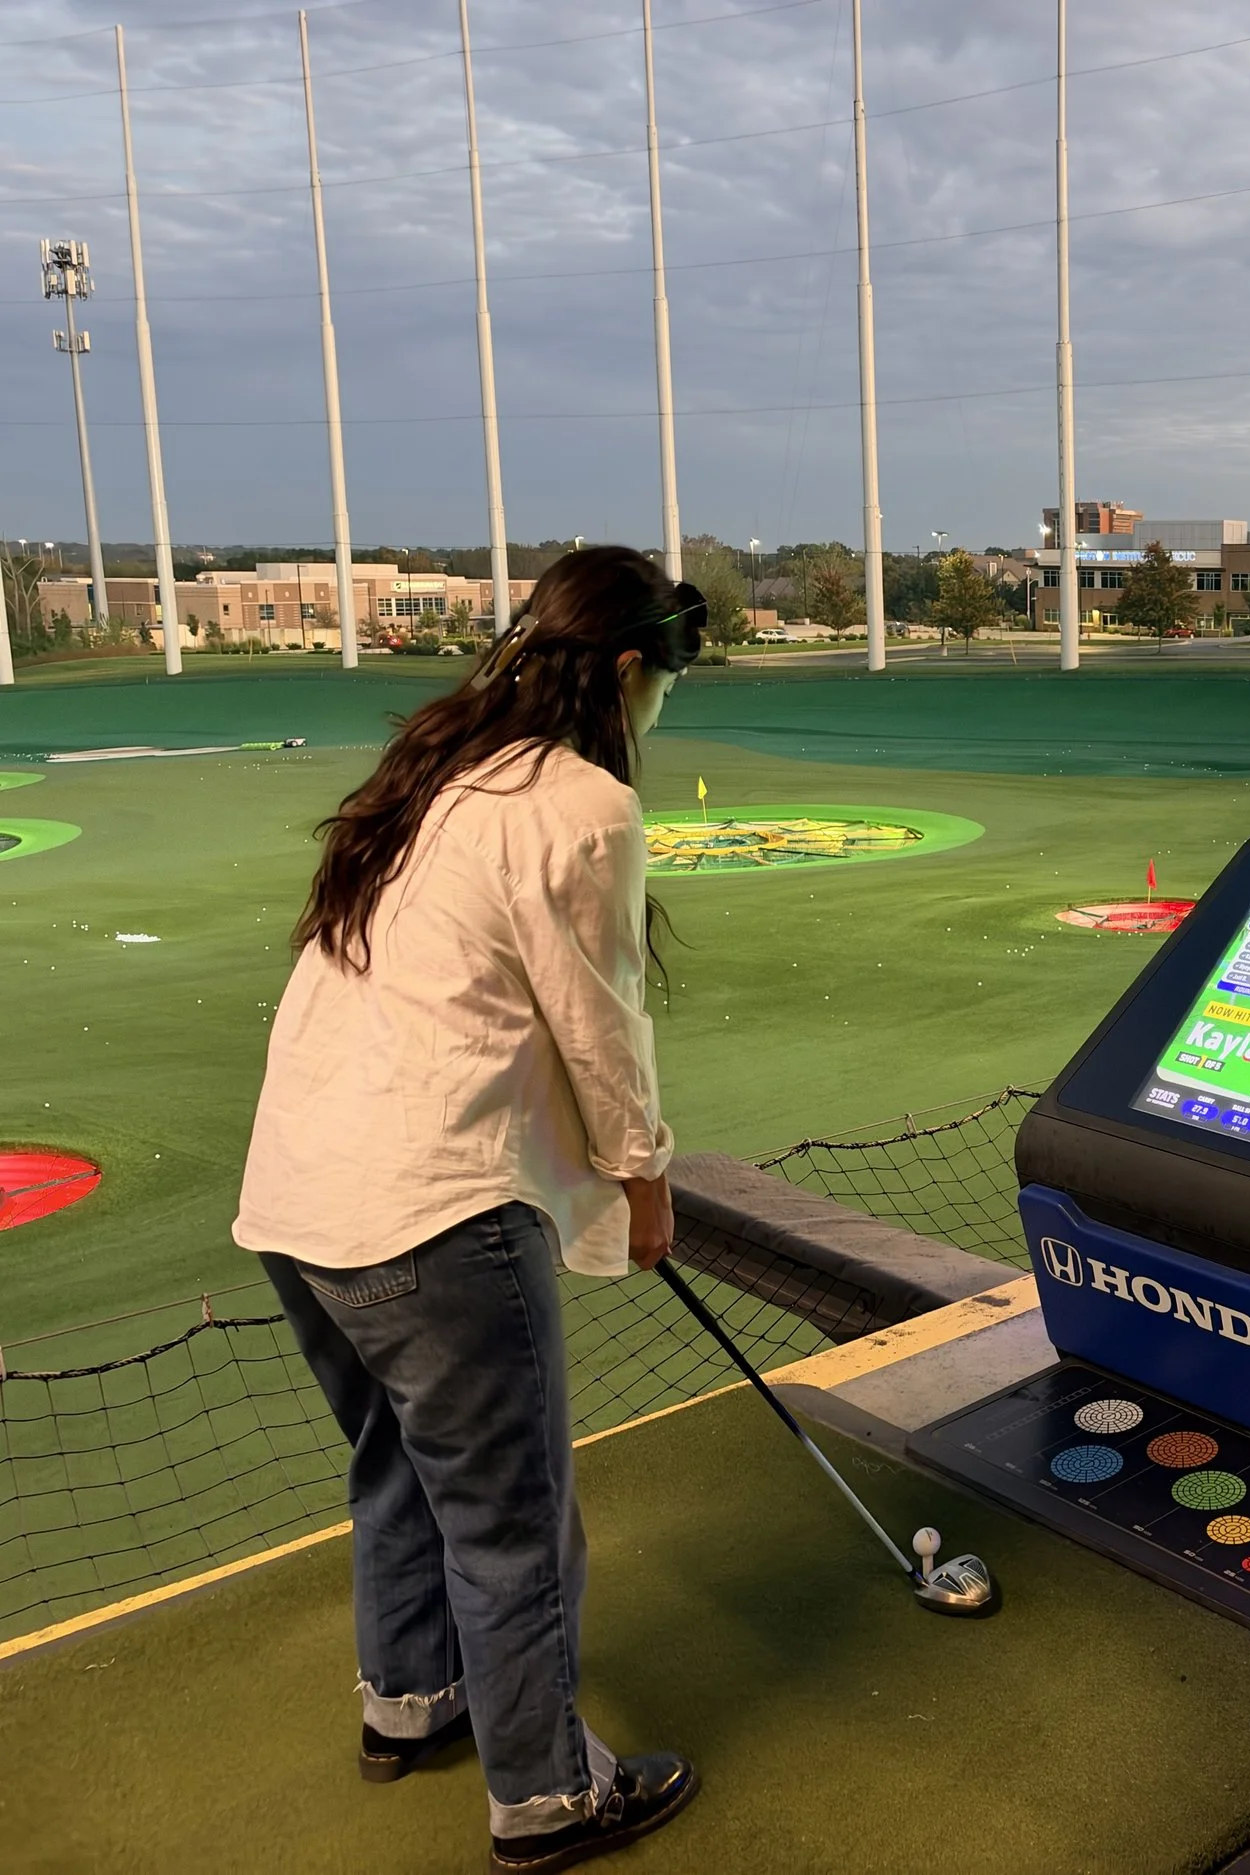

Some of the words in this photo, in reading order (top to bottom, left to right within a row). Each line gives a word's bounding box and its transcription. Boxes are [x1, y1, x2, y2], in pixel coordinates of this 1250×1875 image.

[1208, 1005, 1234, 1018] NOW
[1178, 1053, 1201, 1065] SHOT
[1197, 1055, 1208, 1069] 1
[1204, 1060, 1215, 1069] OF
[1148, 1087, 1181, 1104] STATS
[1191, 1104, 1209, 1115] 27.9
